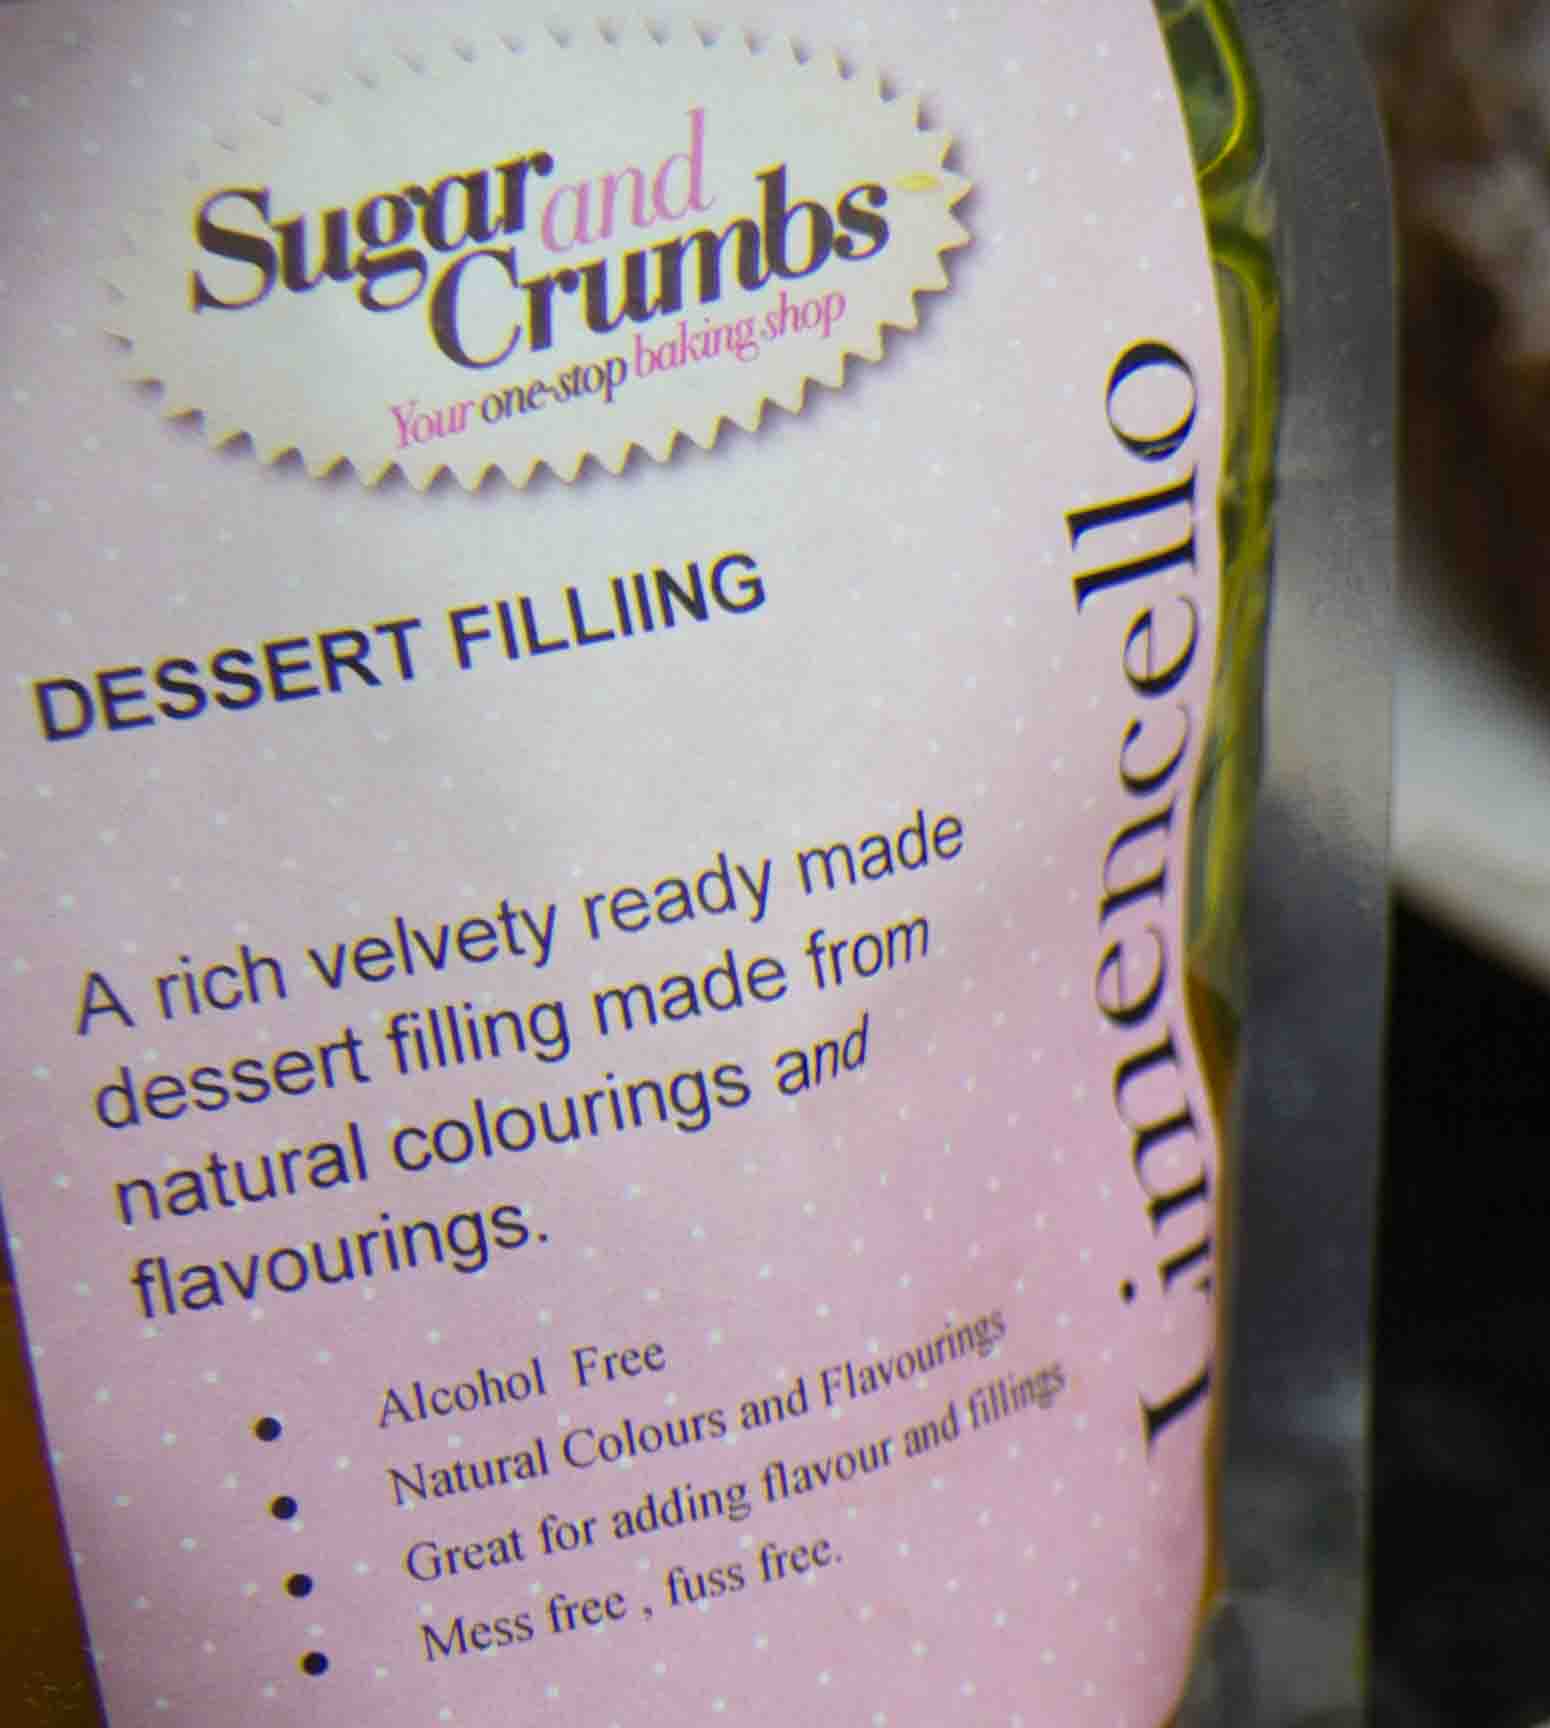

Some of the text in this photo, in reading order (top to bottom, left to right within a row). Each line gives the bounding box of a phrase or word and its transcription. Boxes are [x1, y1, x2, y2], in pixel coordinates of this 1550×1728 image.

[189, 106, 716, 314] Sugar and
[428, 162, 891, 370] Crumbs
[388, 289, 847, 449] Your one-stop baking shop
[34, 550, 769, 743] DESSERT FILLIING
[75, 805, 966, 1035] A rich velvety ready made
[94, 911, 932, 1131] dessert filling made from
[113, 1013, 872, 1227] natural colourings and
[132, 1196, 551, 1320] flavourings.
[378, 1340, 667, 1429] Alcohol Free
[387, 1308, 1007, 1507] Natural Colours and Flavourings
[406, 1361, 1068, 1583] Great for adding flavour and fillings
[420, 1612, 536, 1663] Mess
[546, 1591, 628, 1634] free
[665, 1561, 746, 1607] fuss
[757, 1537, 844, 1585] free.
